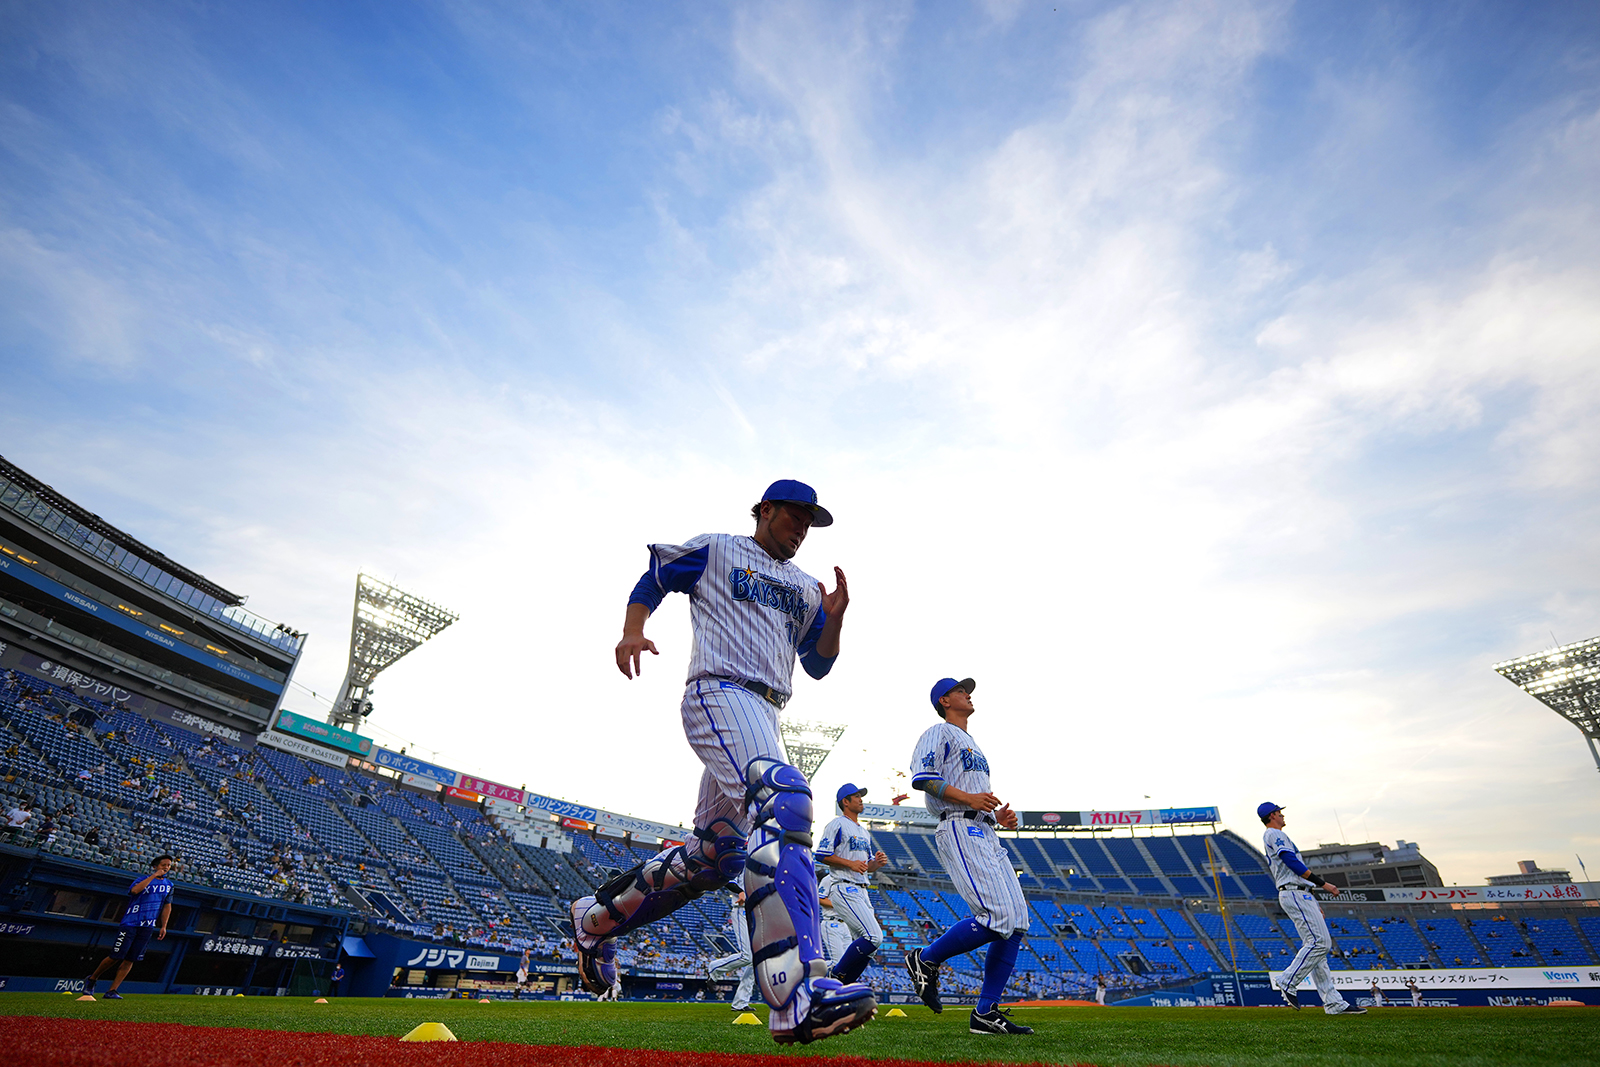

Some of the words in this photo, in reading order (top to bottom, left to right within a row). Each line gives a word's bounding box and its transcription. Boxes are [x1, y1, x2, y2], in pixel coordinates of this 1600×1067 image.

[64, 591, 99, 612] NISSAN
[144, 630, 175, 648] NISSAN
[216, 662, 231, 673] STAR
[232, 667, 251, 680] SUITES
[51, 665, 132, 702] 損保ジャパン
[270, 733, 283, 743] UNI
[283, 739, 310, 753] COFFEE
[310, 748, 345, 763] ROASTERY
[391, 757, 420, 773] ボイス
[474, 780, 521, 802] 東京バス
[540, 797, 596, 820] リビングライフ
[1090, 811, 1143, 824] オカムラ
[1170, 810, 1215, 821] メモワール
[616, 818, 665, 835] ホットスタッフ
[1415, 889, 1478, 901] ハーバー
[1487, 890, 1522, 898] ふとんの
[407, 948, 465, 969] ノジマ
[771, 971, 787, 986] 10
